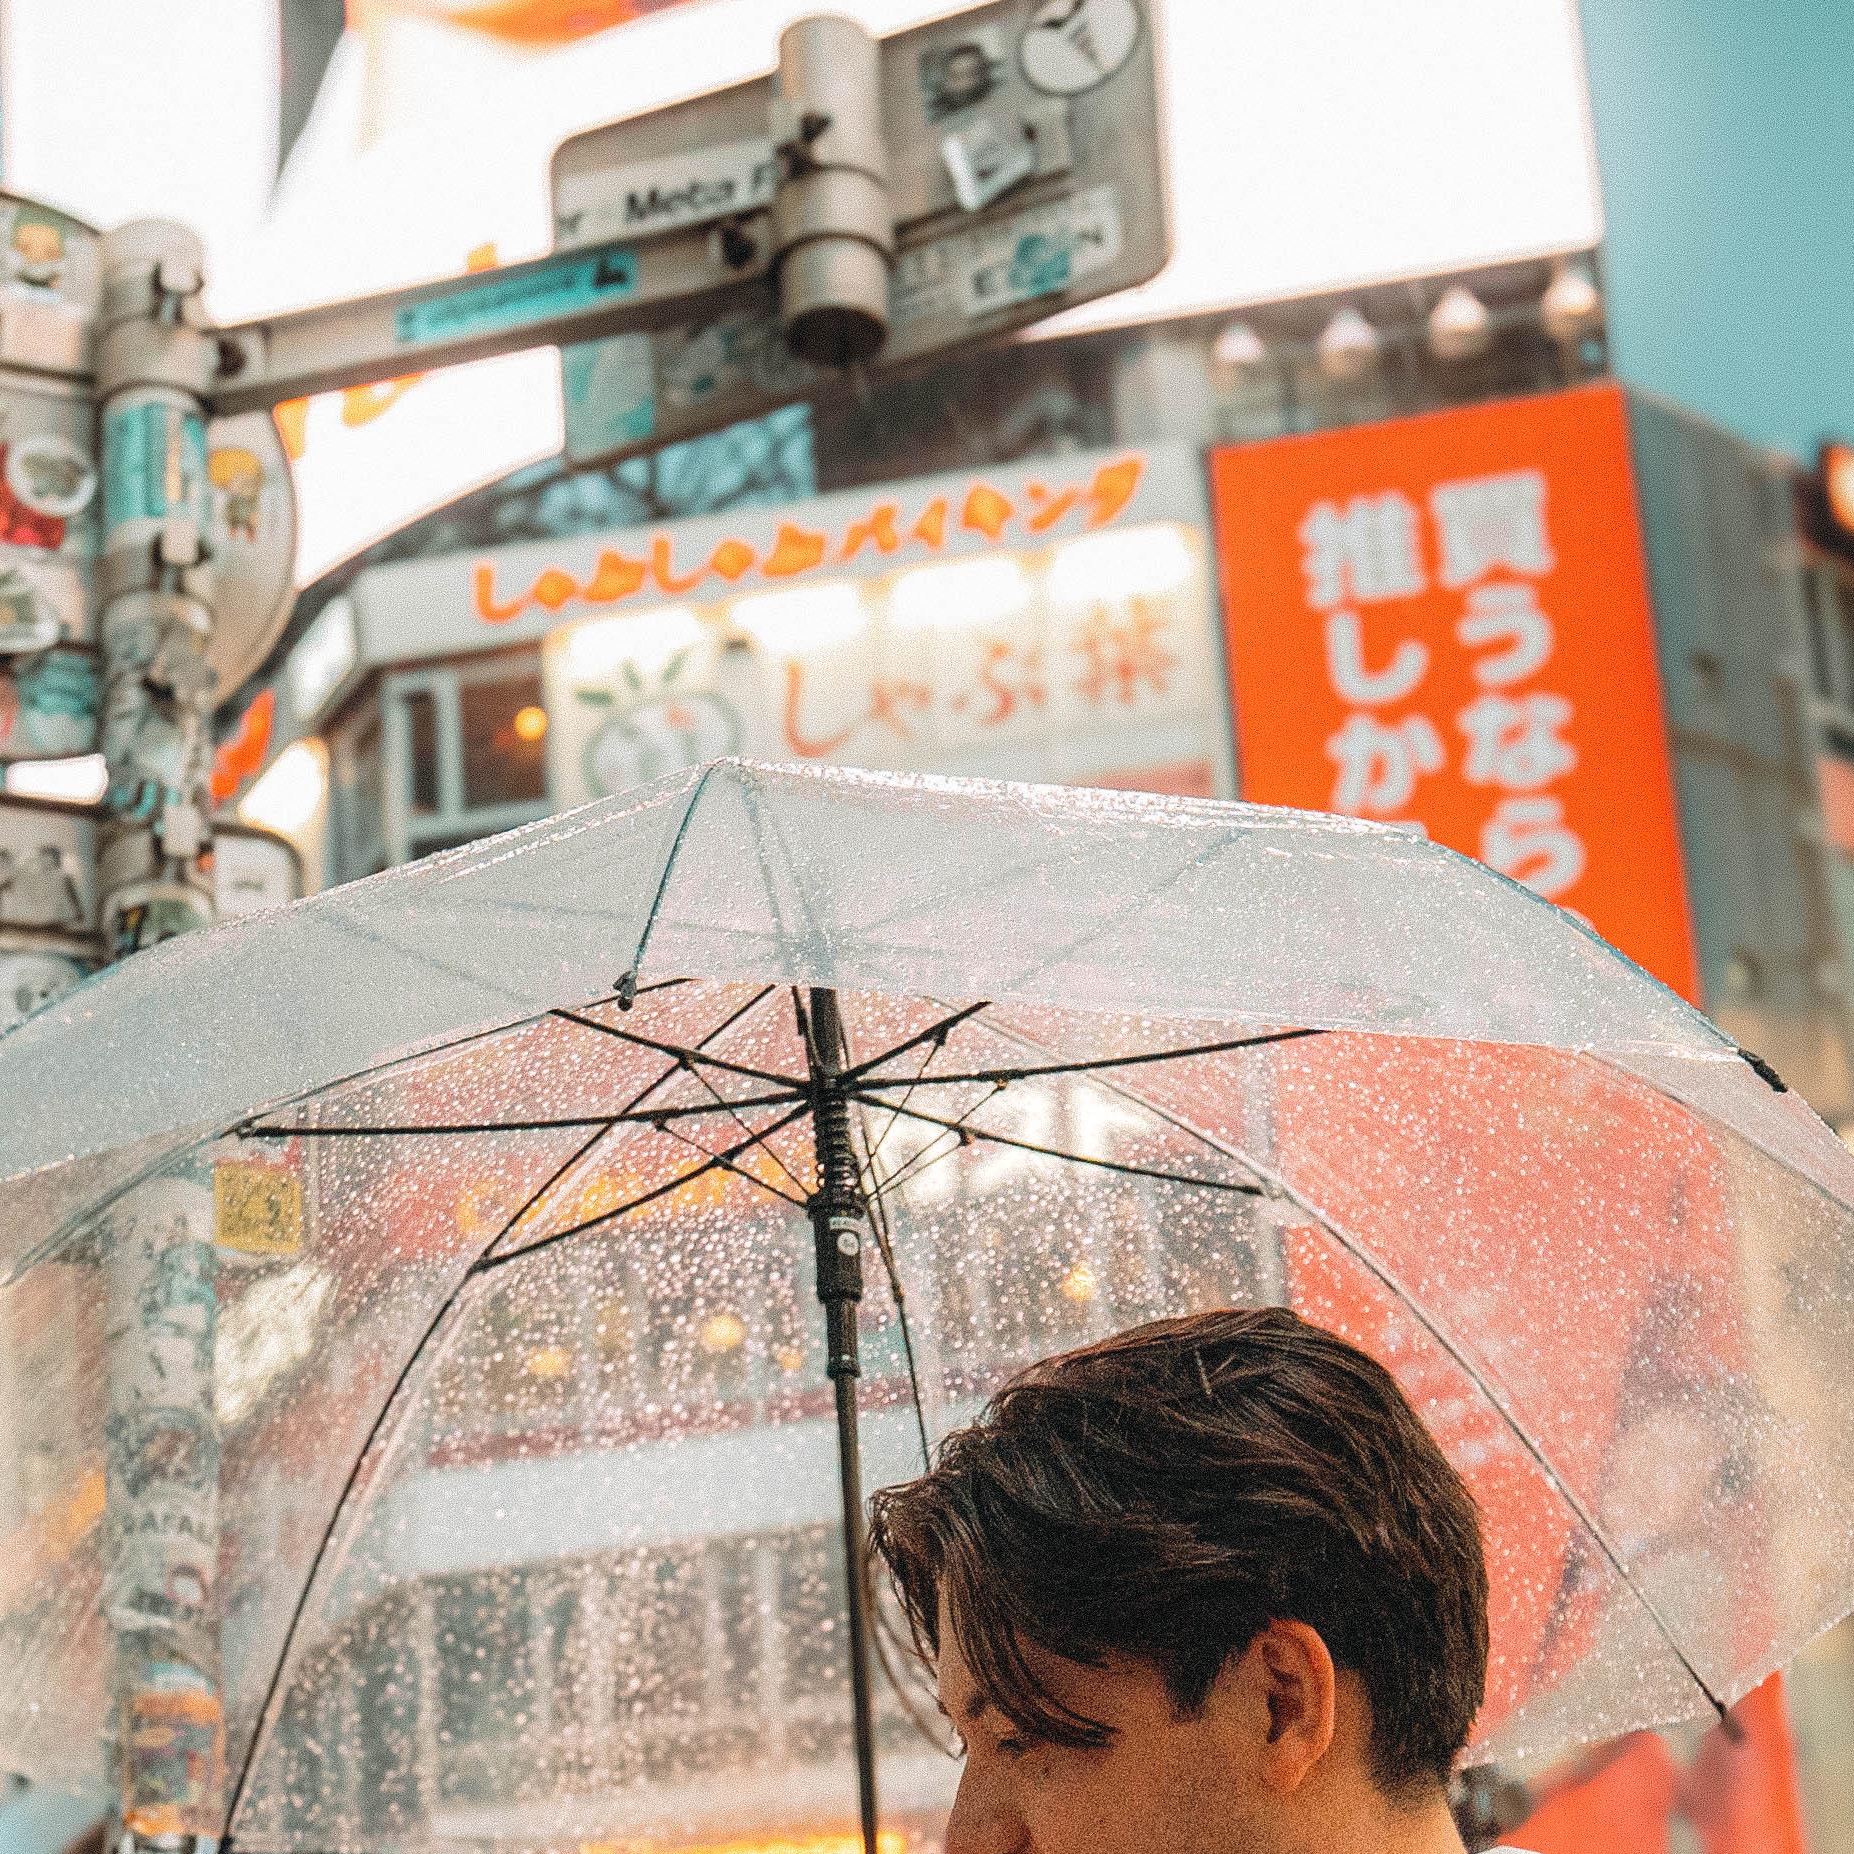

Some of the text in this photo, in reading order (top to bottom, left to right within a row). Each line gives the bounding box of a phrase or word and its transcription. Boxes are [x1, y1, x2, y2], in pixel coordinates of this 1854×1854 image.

[1297, 490, 1447, 842] 推しか
[1430, 468, 1597, 932] 買うなら
